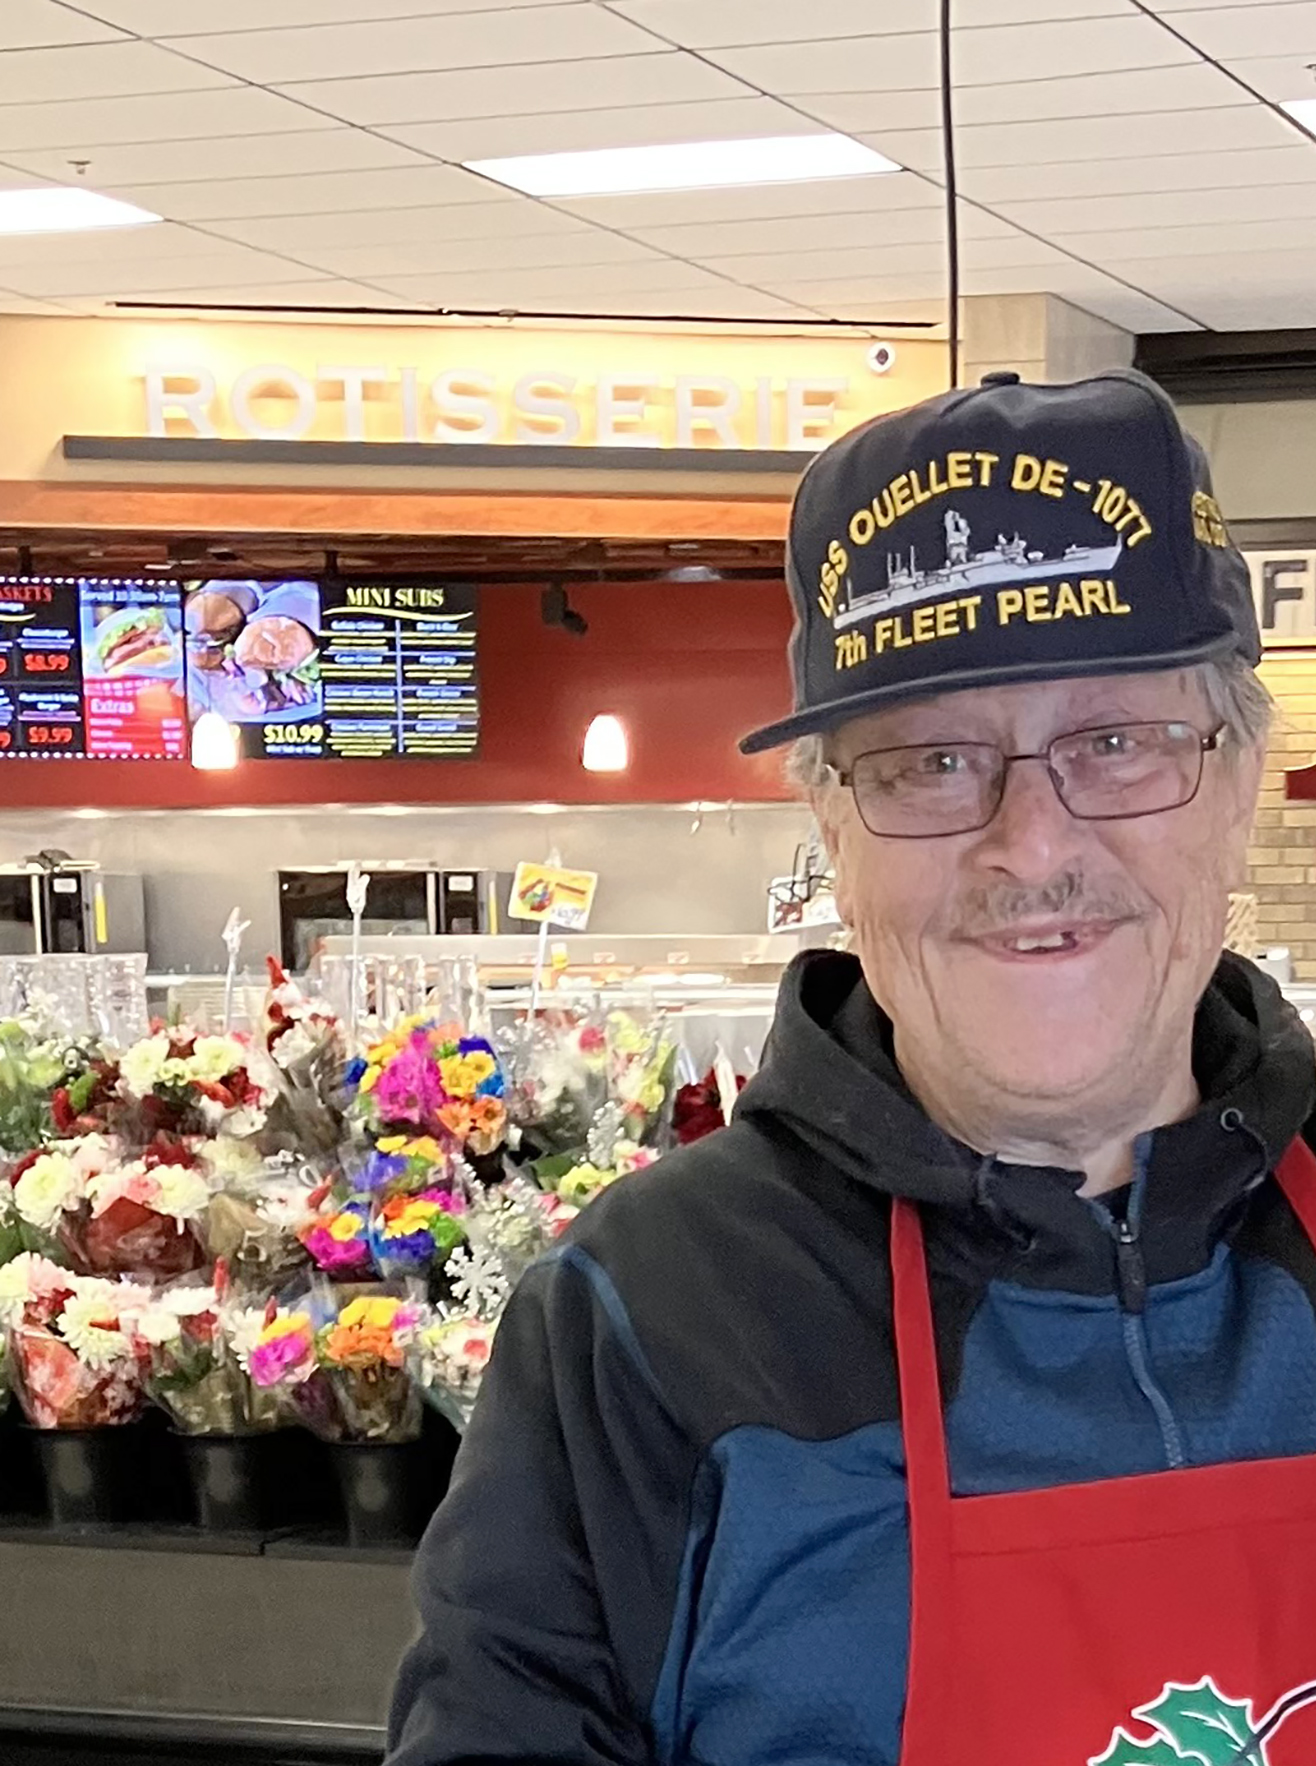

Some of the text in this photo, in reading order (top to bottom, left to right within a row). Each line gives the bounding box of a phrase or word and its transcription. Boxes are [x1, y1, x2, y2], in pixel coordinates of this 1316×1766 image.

[144, 363, 848, 452] ROTISSERIE
[818, 540, 848, 619] USS
[849, 452, 999, 545] OUELLET
[346, 586, 445, 608] MINI SUBS
[835, 579, 1132, 671] 7th FLEET PEARL
[264, 724, 323, 743] $10.99
